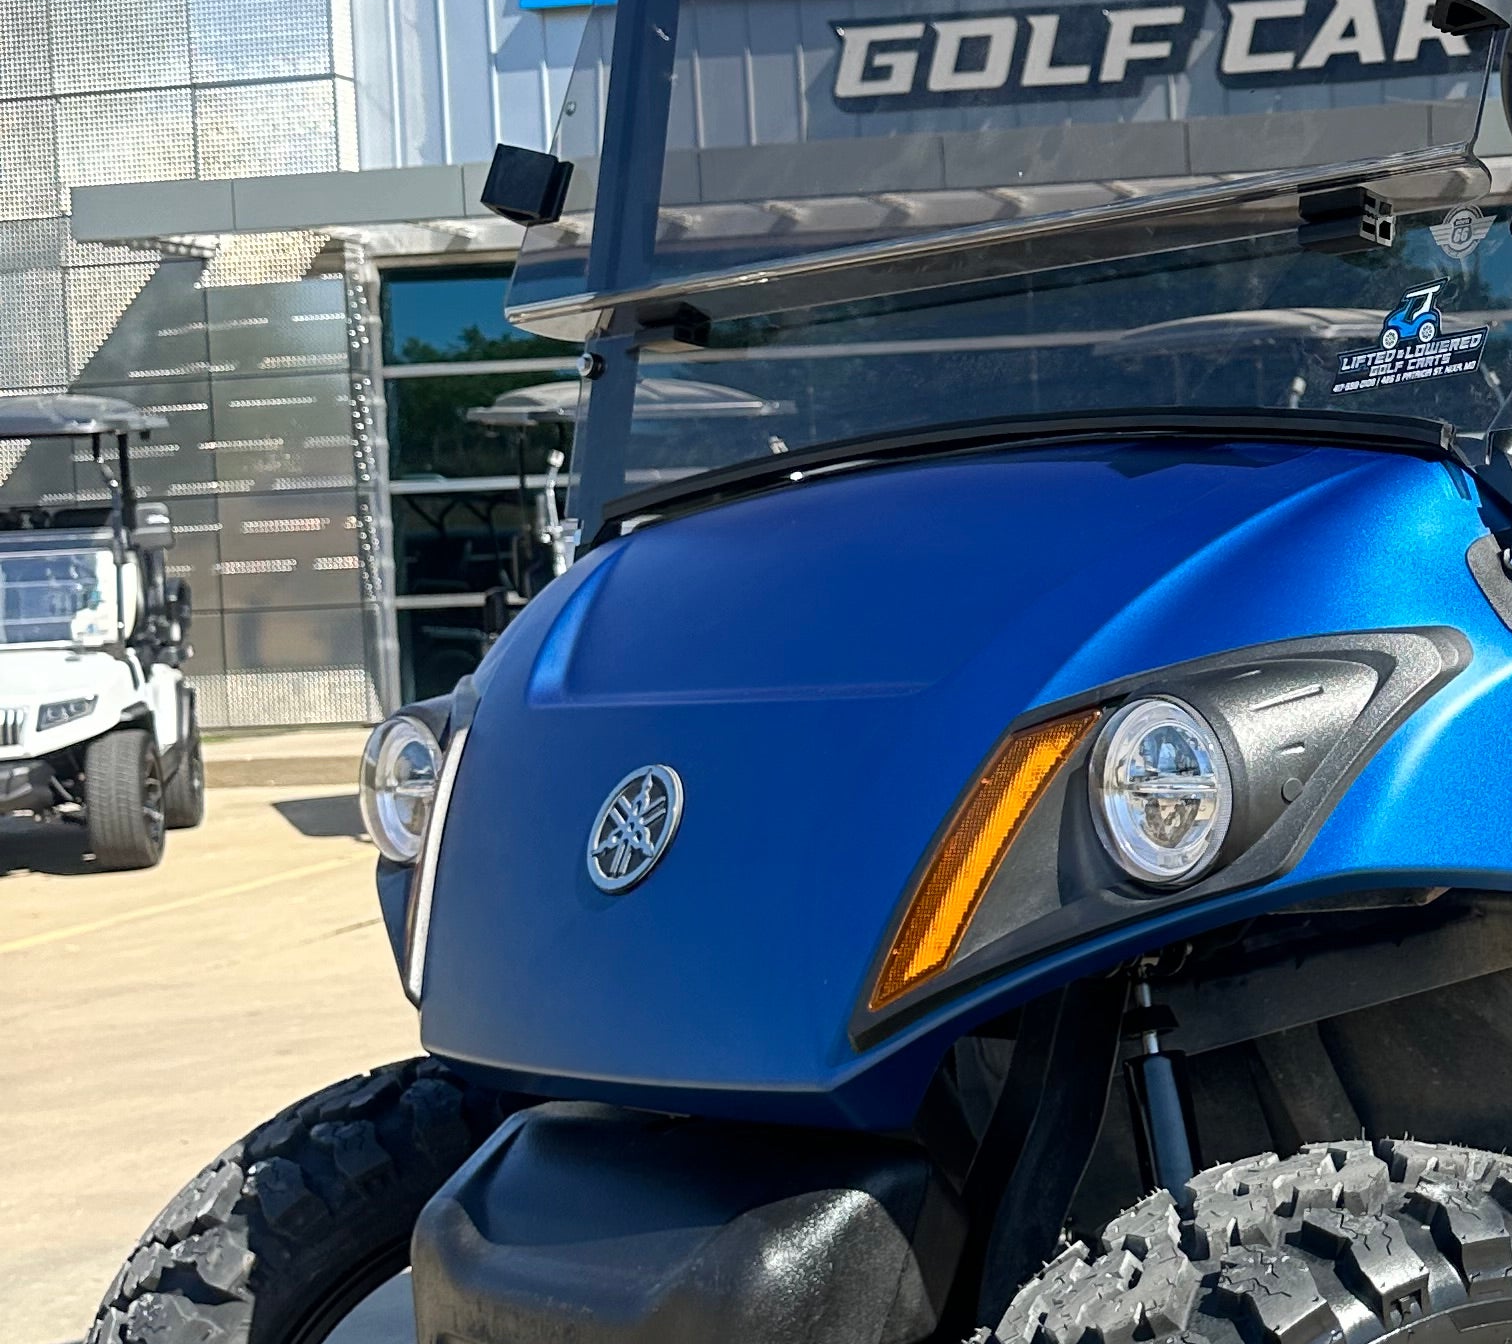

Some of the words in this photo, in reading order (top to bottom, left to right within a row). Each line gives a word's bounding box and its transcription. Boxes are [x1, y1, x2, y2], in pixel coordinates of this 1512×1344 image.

[834, 6, 1186, 99] GOLF
[1340, 348, 1397, 371] LIFTED
[1404, 333, 1482, 359] LOWERED
